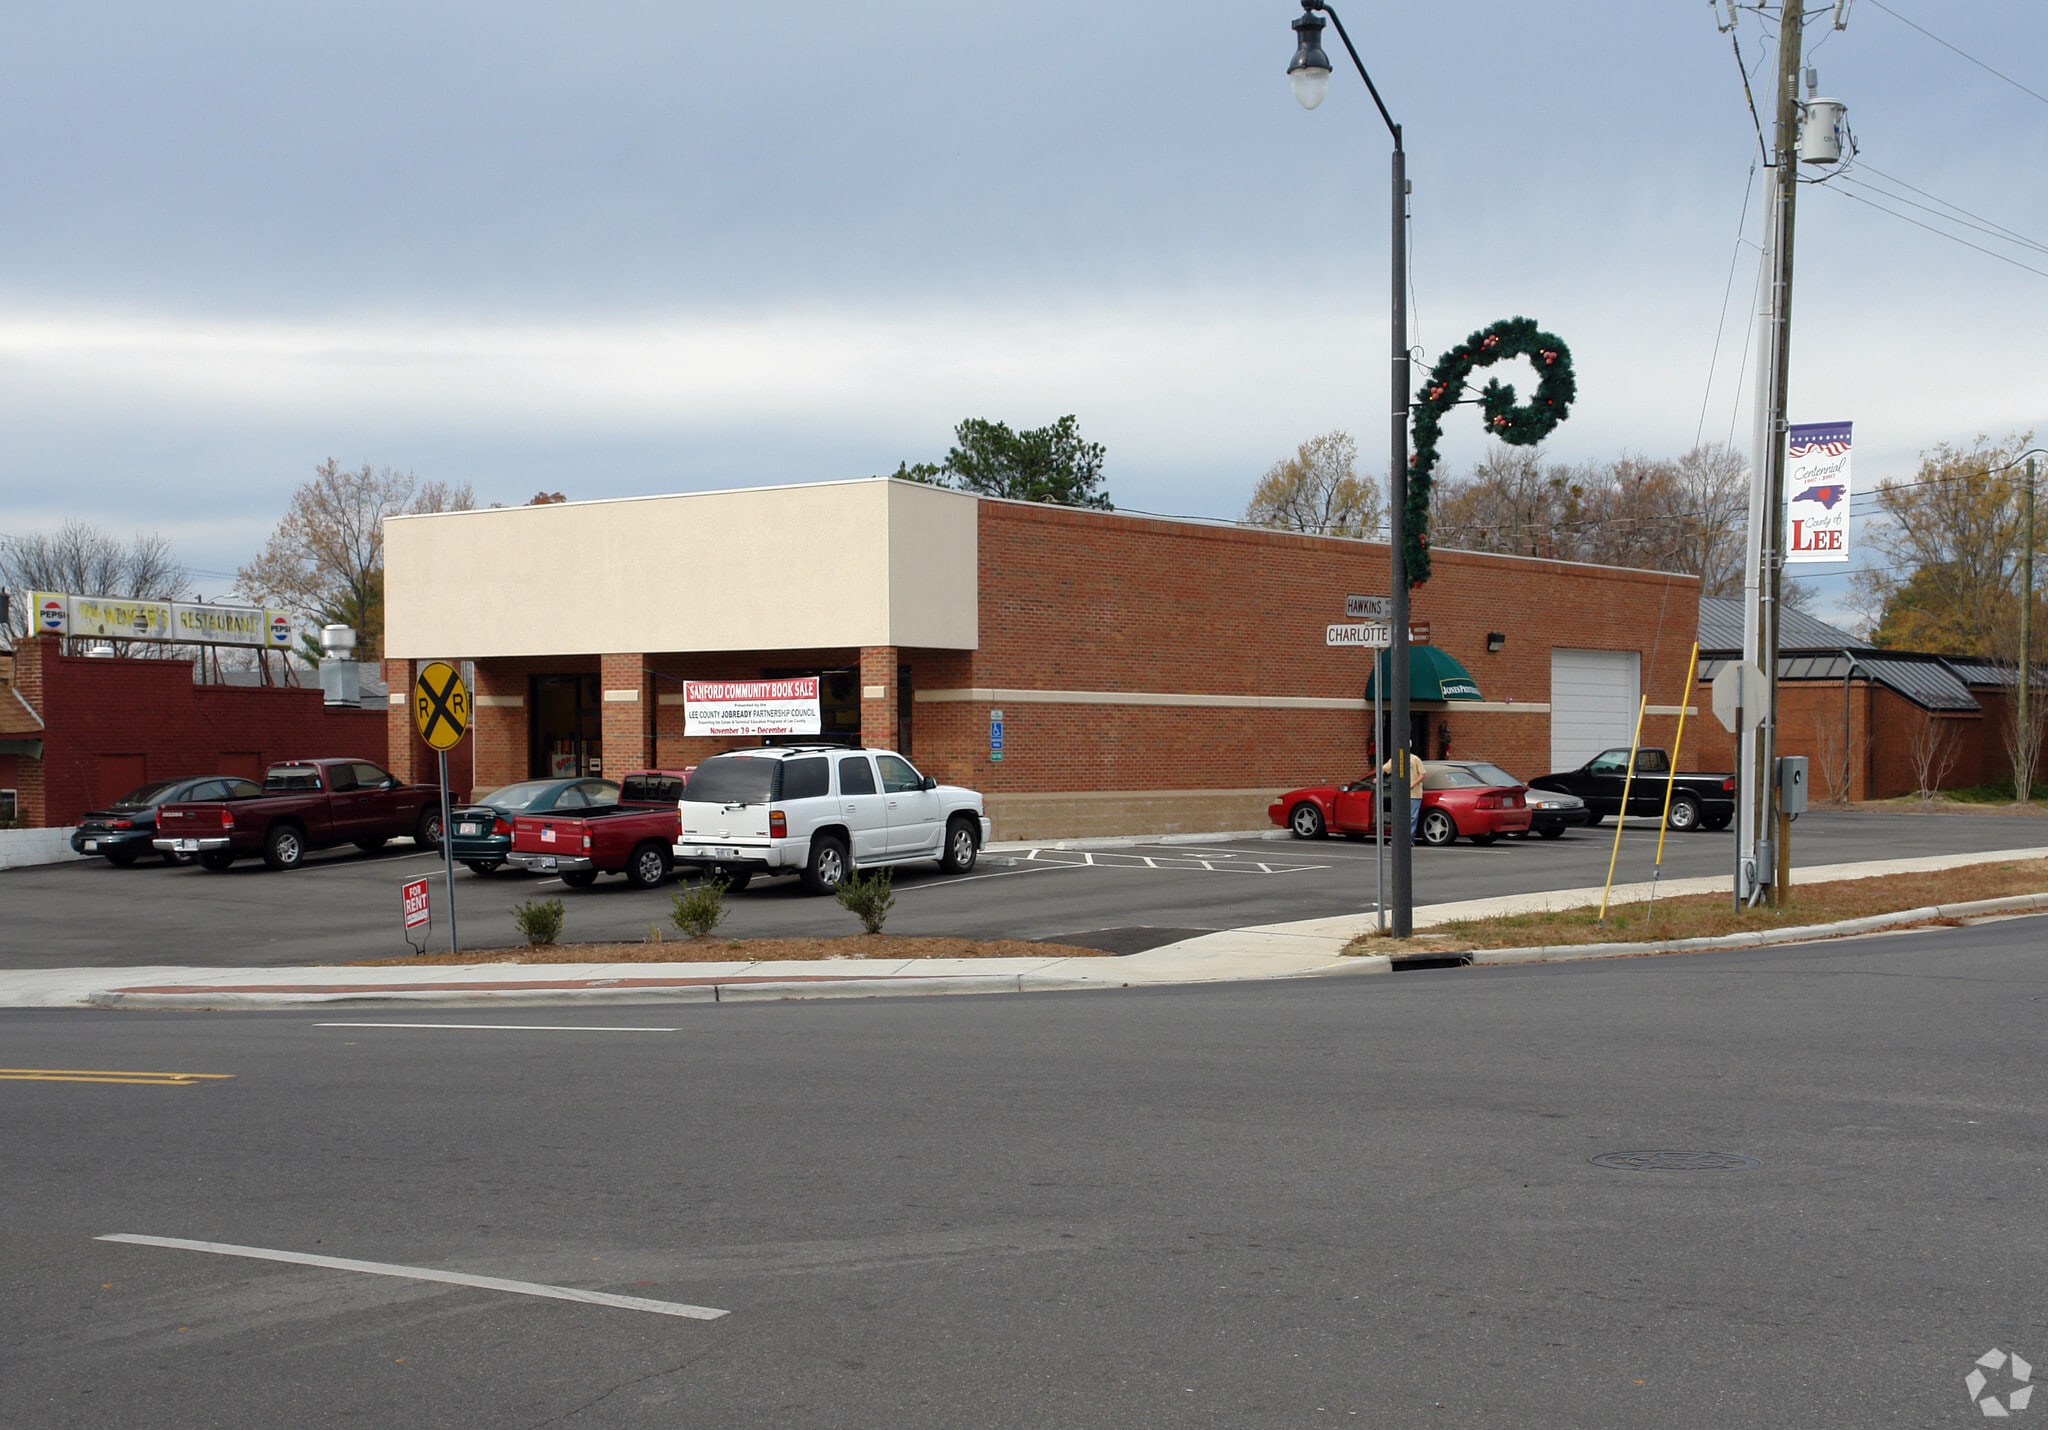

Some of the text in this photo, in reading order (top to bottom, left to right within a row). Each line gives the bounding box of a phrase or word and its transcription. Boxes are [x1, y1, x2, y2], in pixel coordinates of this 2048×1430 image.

[1794, 457, 1846, 480] Centennial
[1805, 512, 1842, 528] County of
[1791, 520, 1842, 551] LEE
[40, 610, 66, 620] PEPSI
[1348, 599, 1382, 615] HAWKINS
[180, 612, 257, 633] RESTAURANT
[270, 625, 290, 633] PEPSI
[1328, 627, 1388, 642] CHARLOTTE
[689, 681, 814, 699] SANFORD COMMUNITY BOOK SALE
[418, 692, 464, 718] R R
[689, 708, 816, 719] LEE COUNTY JOBREADY PARTNERSHIP COUNCIL
[710, 727, 739, 735] November
[409, 885, 421, 898] FOR
[406, 893, 427, 915] RENT
